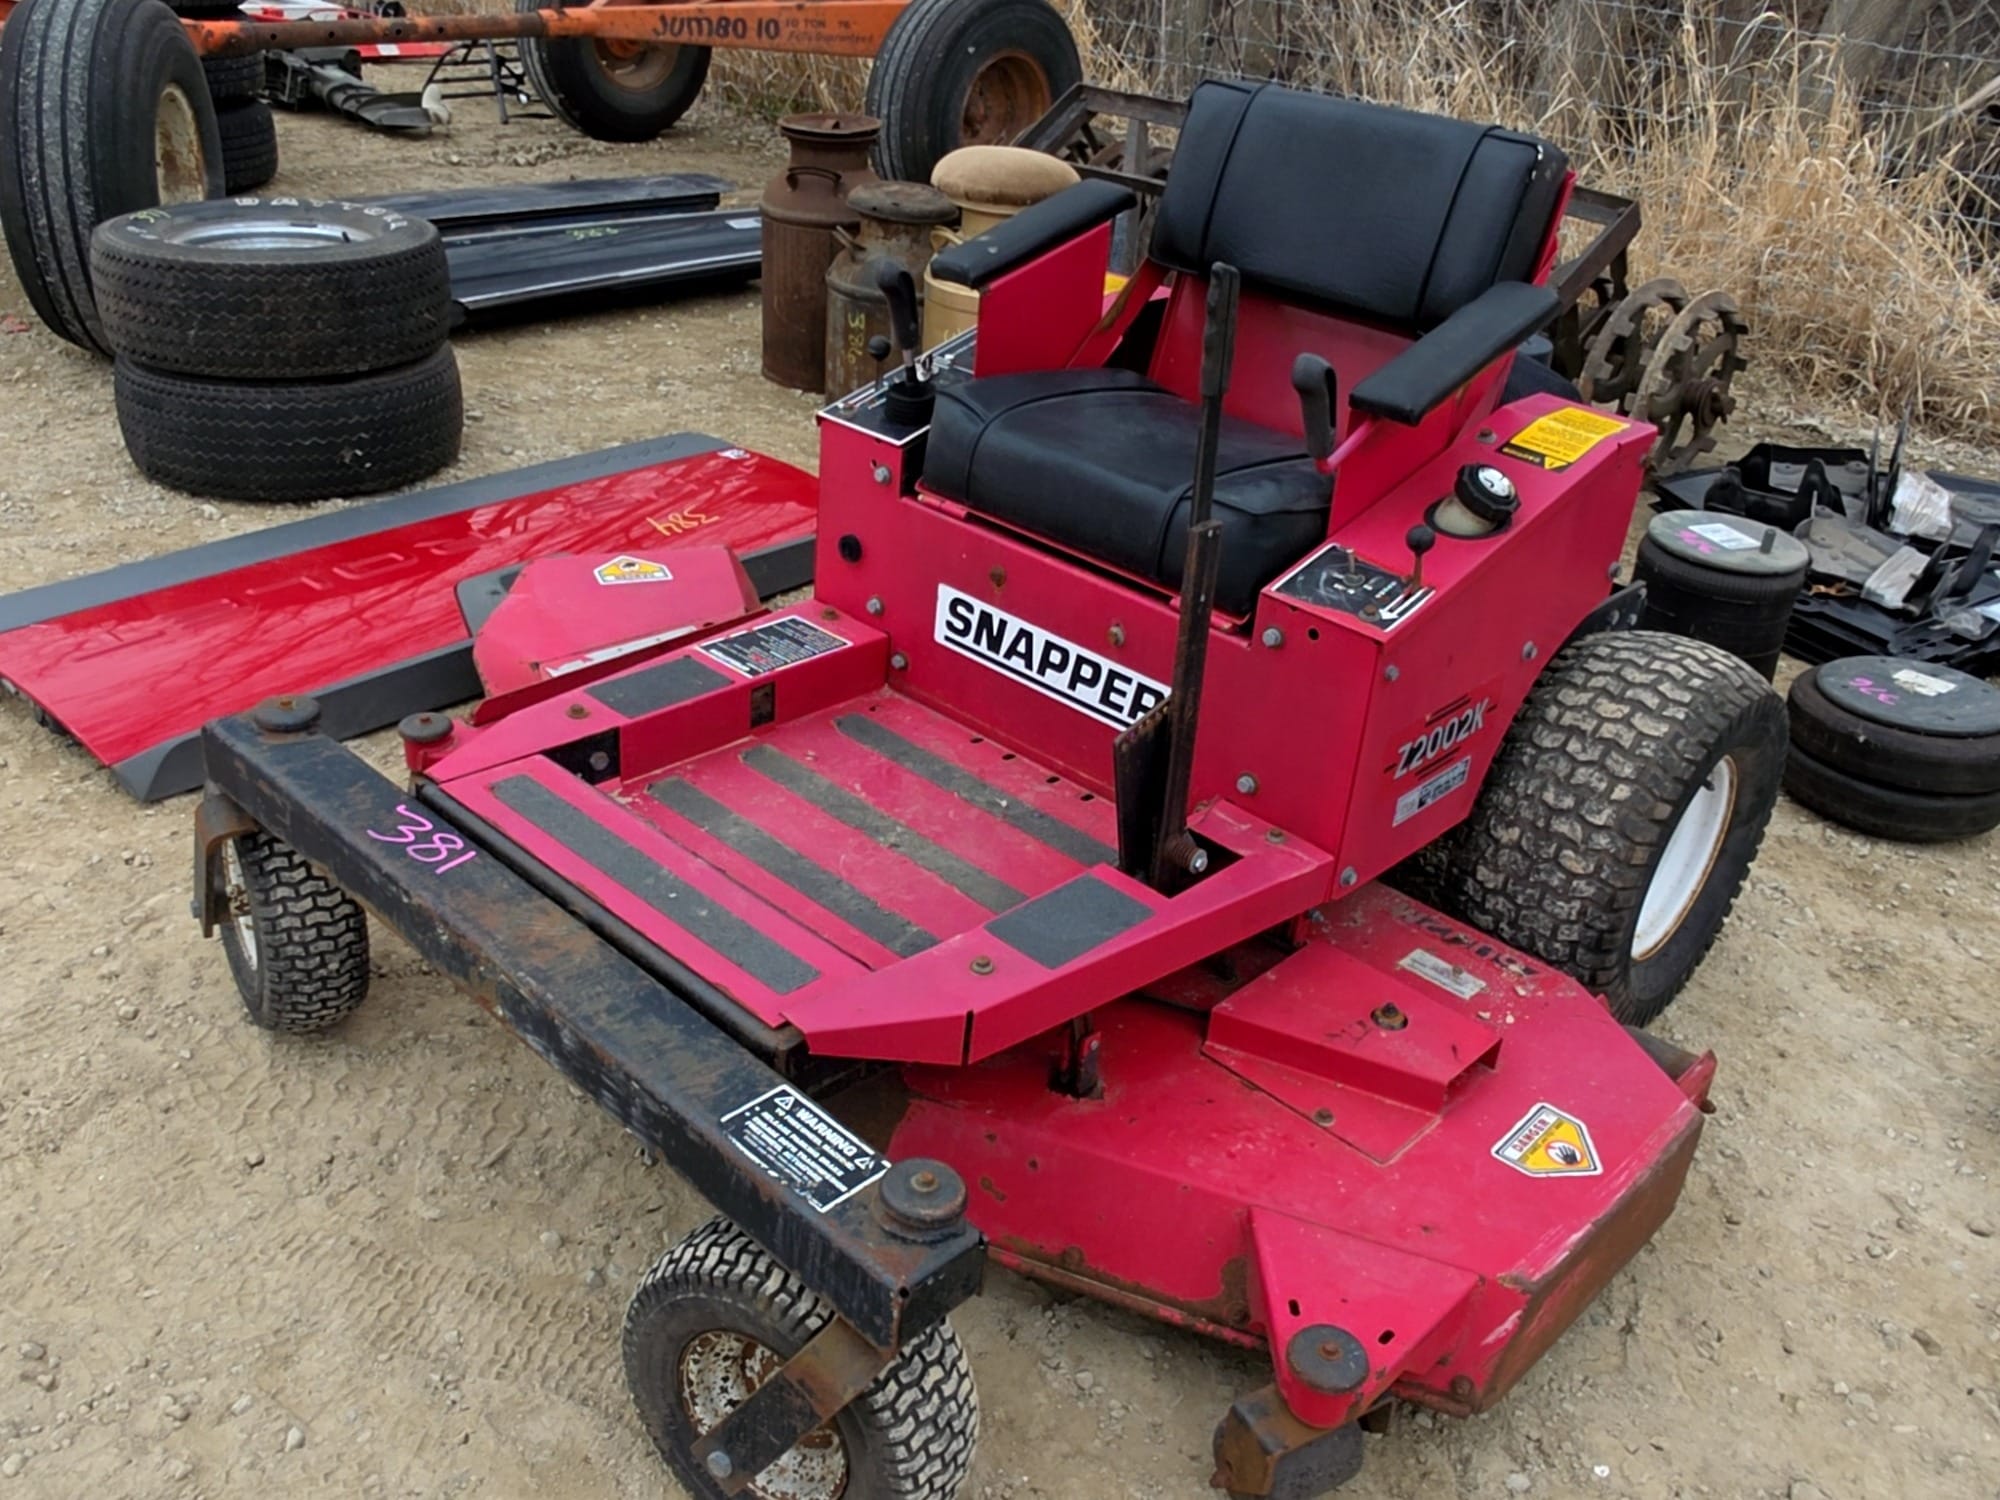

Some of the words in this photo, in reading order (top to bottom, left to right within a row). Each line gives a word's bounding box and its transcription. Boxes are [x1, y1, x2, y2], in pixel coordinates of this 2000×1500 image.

[652, 14, 747, 39] JUMBO
[756, 17, 780, 40] 10
[646, 505, 720, 537] 384
[944, 597, 1166, 720] SNAPPER
[1393, 697, 1489, 780] Z2002K
[366, 804, 477, 875] 381
[795, 1108, 859, 1157] WARNING
[1512, 1118, 1550, 1152] DANGER
